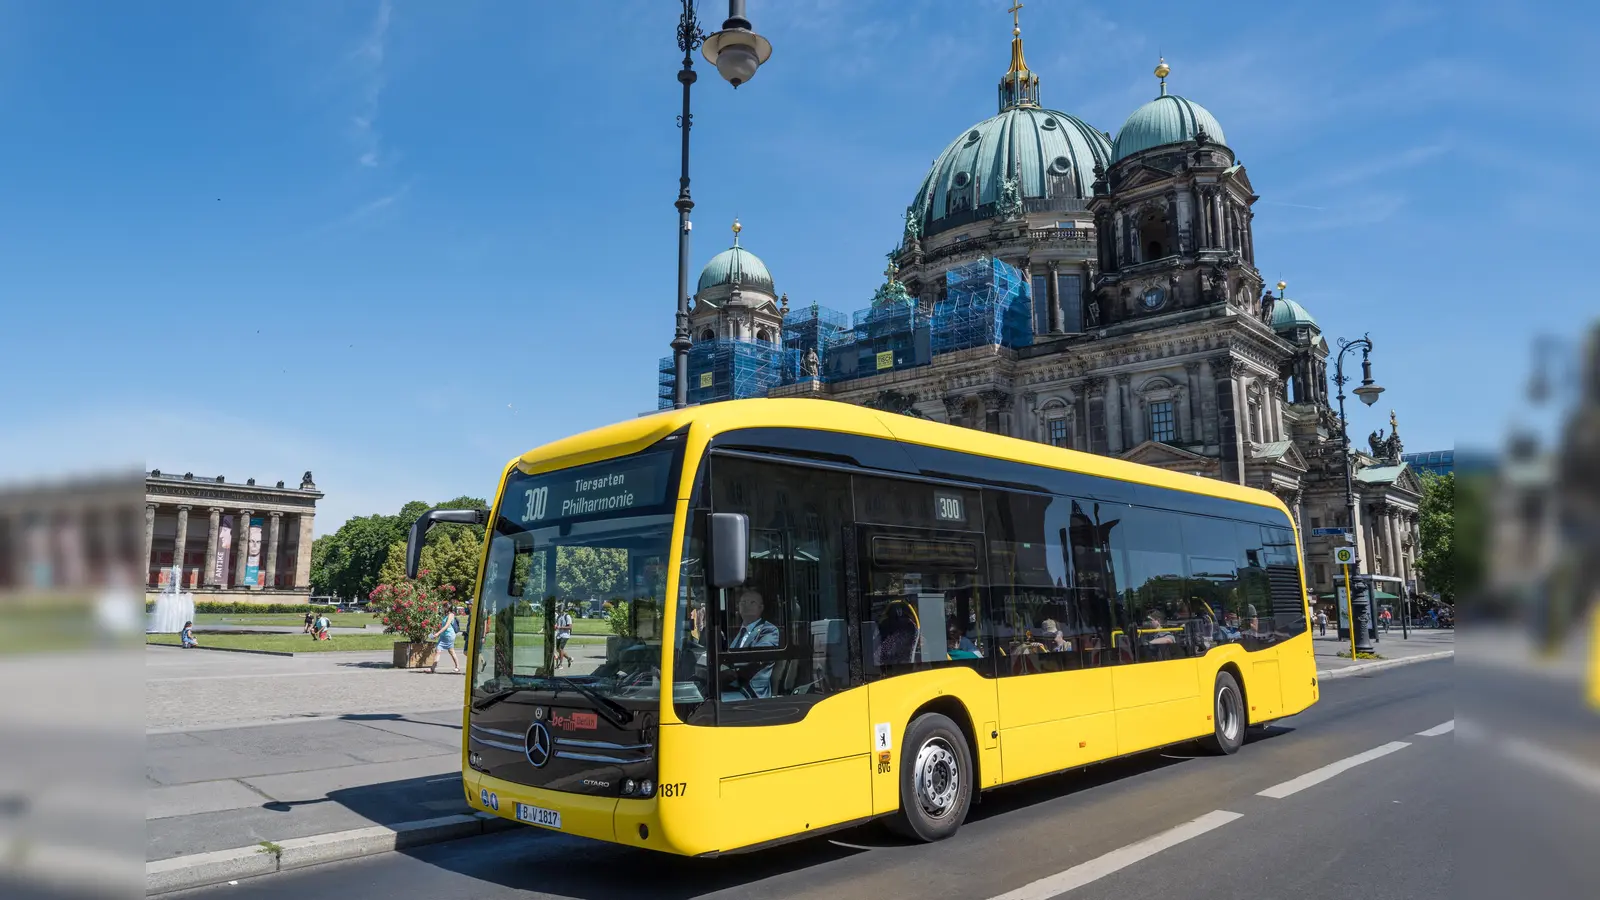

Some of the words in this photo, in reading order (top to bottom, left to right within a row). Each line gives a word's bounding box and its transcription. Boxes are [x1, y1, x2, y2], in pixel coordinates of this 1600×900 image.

[575, 474, 625, 492] Tiergarten
[521, 486, 548, 522] 300
[561, 490, 634, 516] Philharmonie
[940, 497, 960, 519] 300
[215, 551, 225, 578] ANTIKE
[878, 763, 890, 774] BVG
[658, 782, 687, 798] 1817
[523, 805, 528, 819] B
[532, 807, 538, 821] V
[538, 809, 558, 826] 1817
